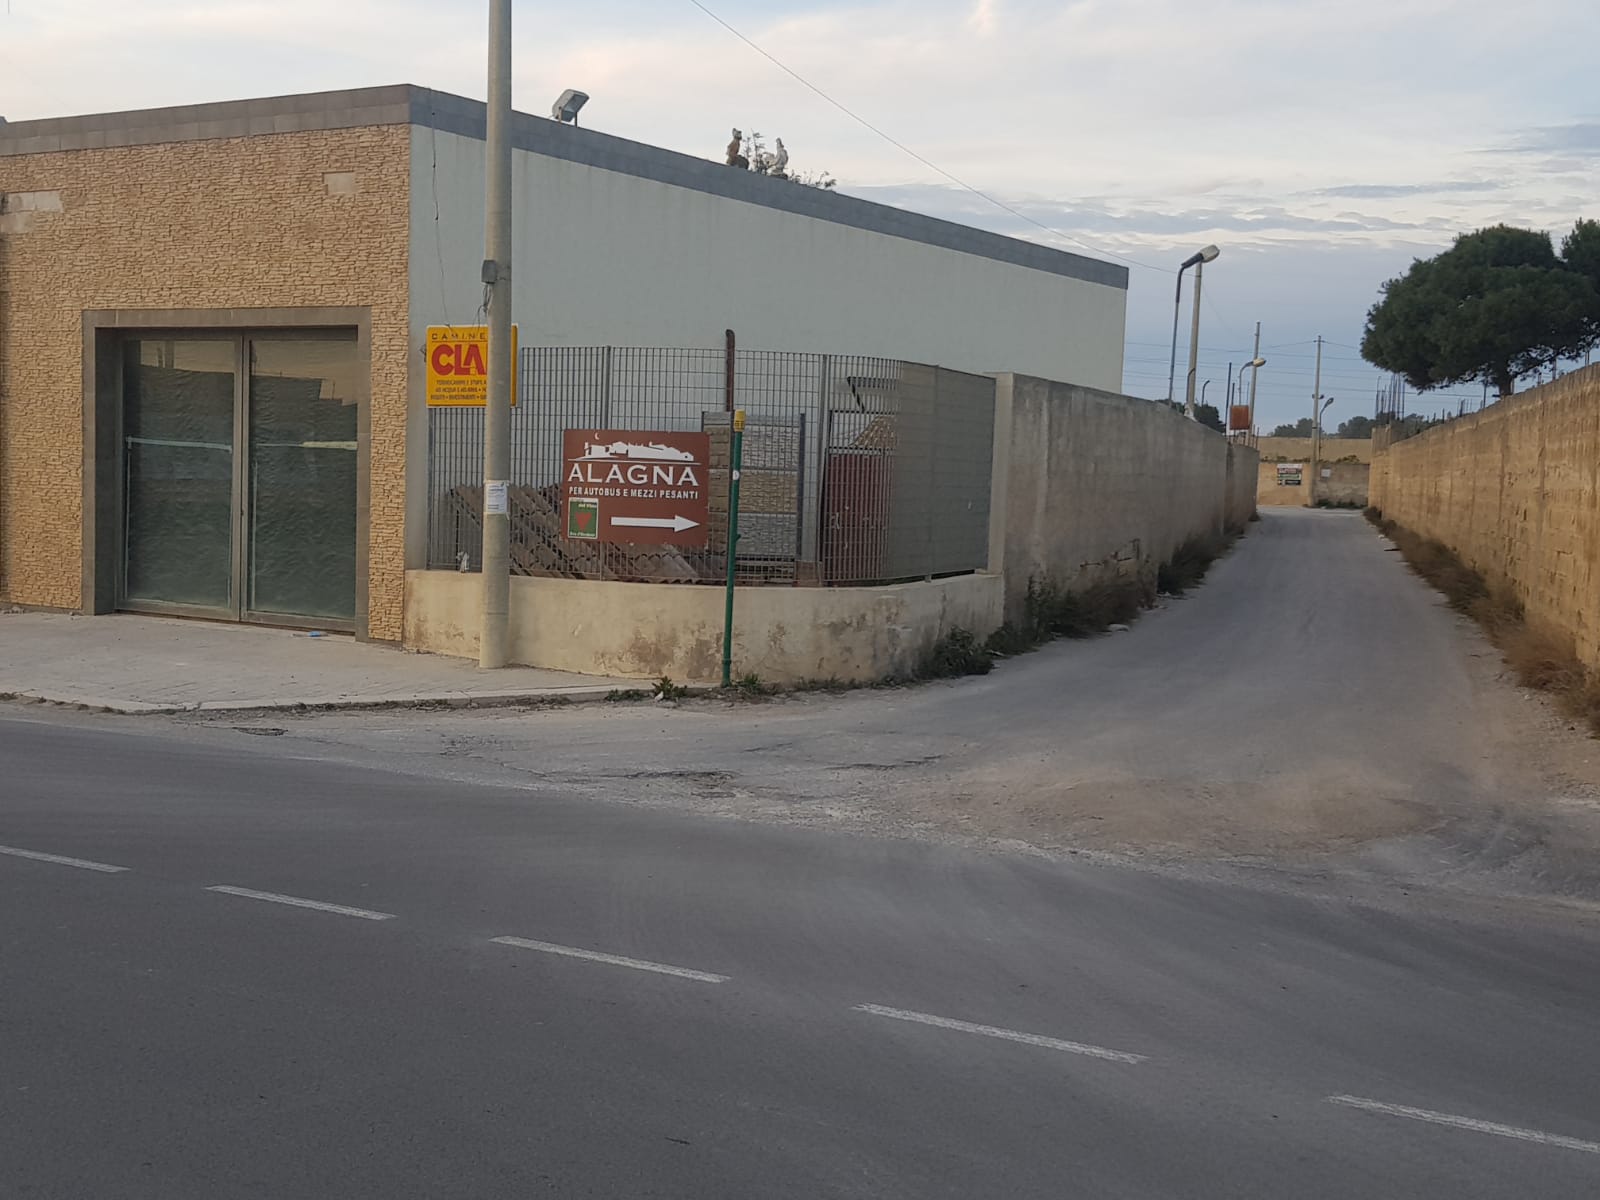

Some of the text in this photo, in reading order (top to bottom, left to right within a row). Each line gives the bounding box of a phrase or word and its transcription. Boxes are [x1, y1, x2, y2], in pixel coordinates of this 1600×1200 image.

[431, 344, 488, 376] CLA
[567, 463, 699, 486] ALAGNA
[568, 486, 698, 499] PER AUTOBUS E MEZZI PESANTI
